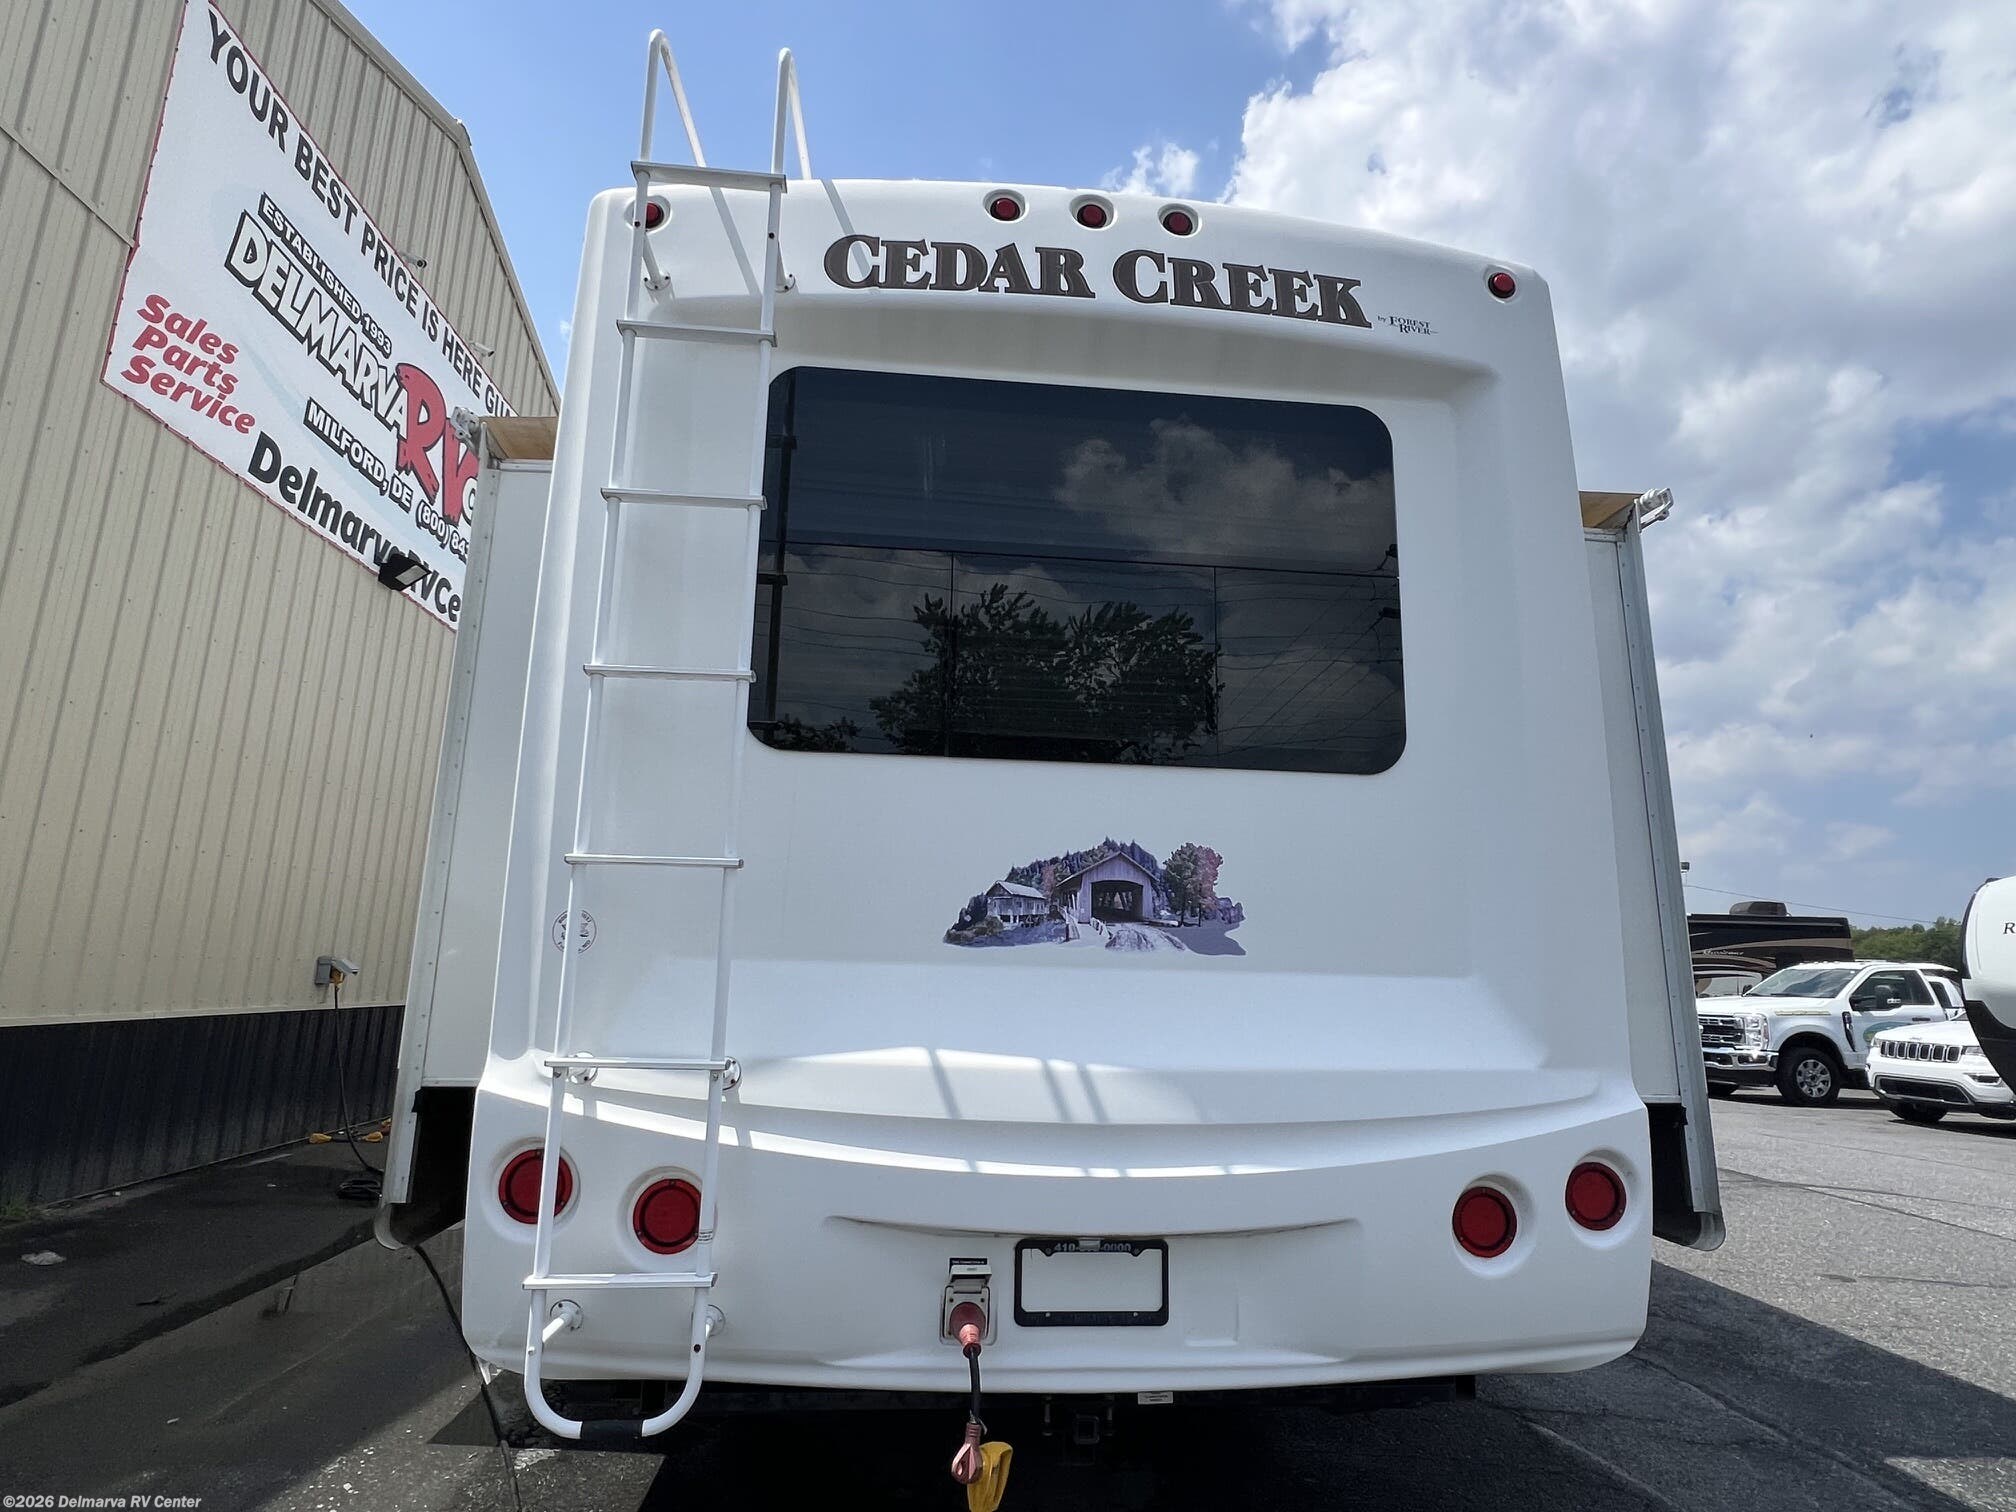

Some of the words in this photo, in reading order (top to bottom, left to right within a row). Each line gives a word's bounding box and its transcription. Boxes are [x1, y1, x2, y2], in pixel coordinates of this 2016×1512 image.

[209, 9, 289, 153] YOUR
[294, 132, 358, 235] BEST
[360, 221, 419, 318] PRICE
[422, 300, 439, 342] IS
[442, 326, 482, 399] HERE
[258, 192, 363, 323] ESTABLISHED
[362, 313, 392, 360] 1993
[823, 233, 1096, 299] CEDAR
[1112, 249, 1373, 329] CREEK
[132, 325, 239, 395] Parts
[137, 294, 239, 364] Sales
[224, 209, 408, 440] DELMARVA
[1400, 323, 1431, 336] RIVER
[120, 355, 256, 434] Service
[303, 397, 389, 496] MILFORD,
[388, 474, 414, 514] DE
[416, 499, 452, 549] (800)
